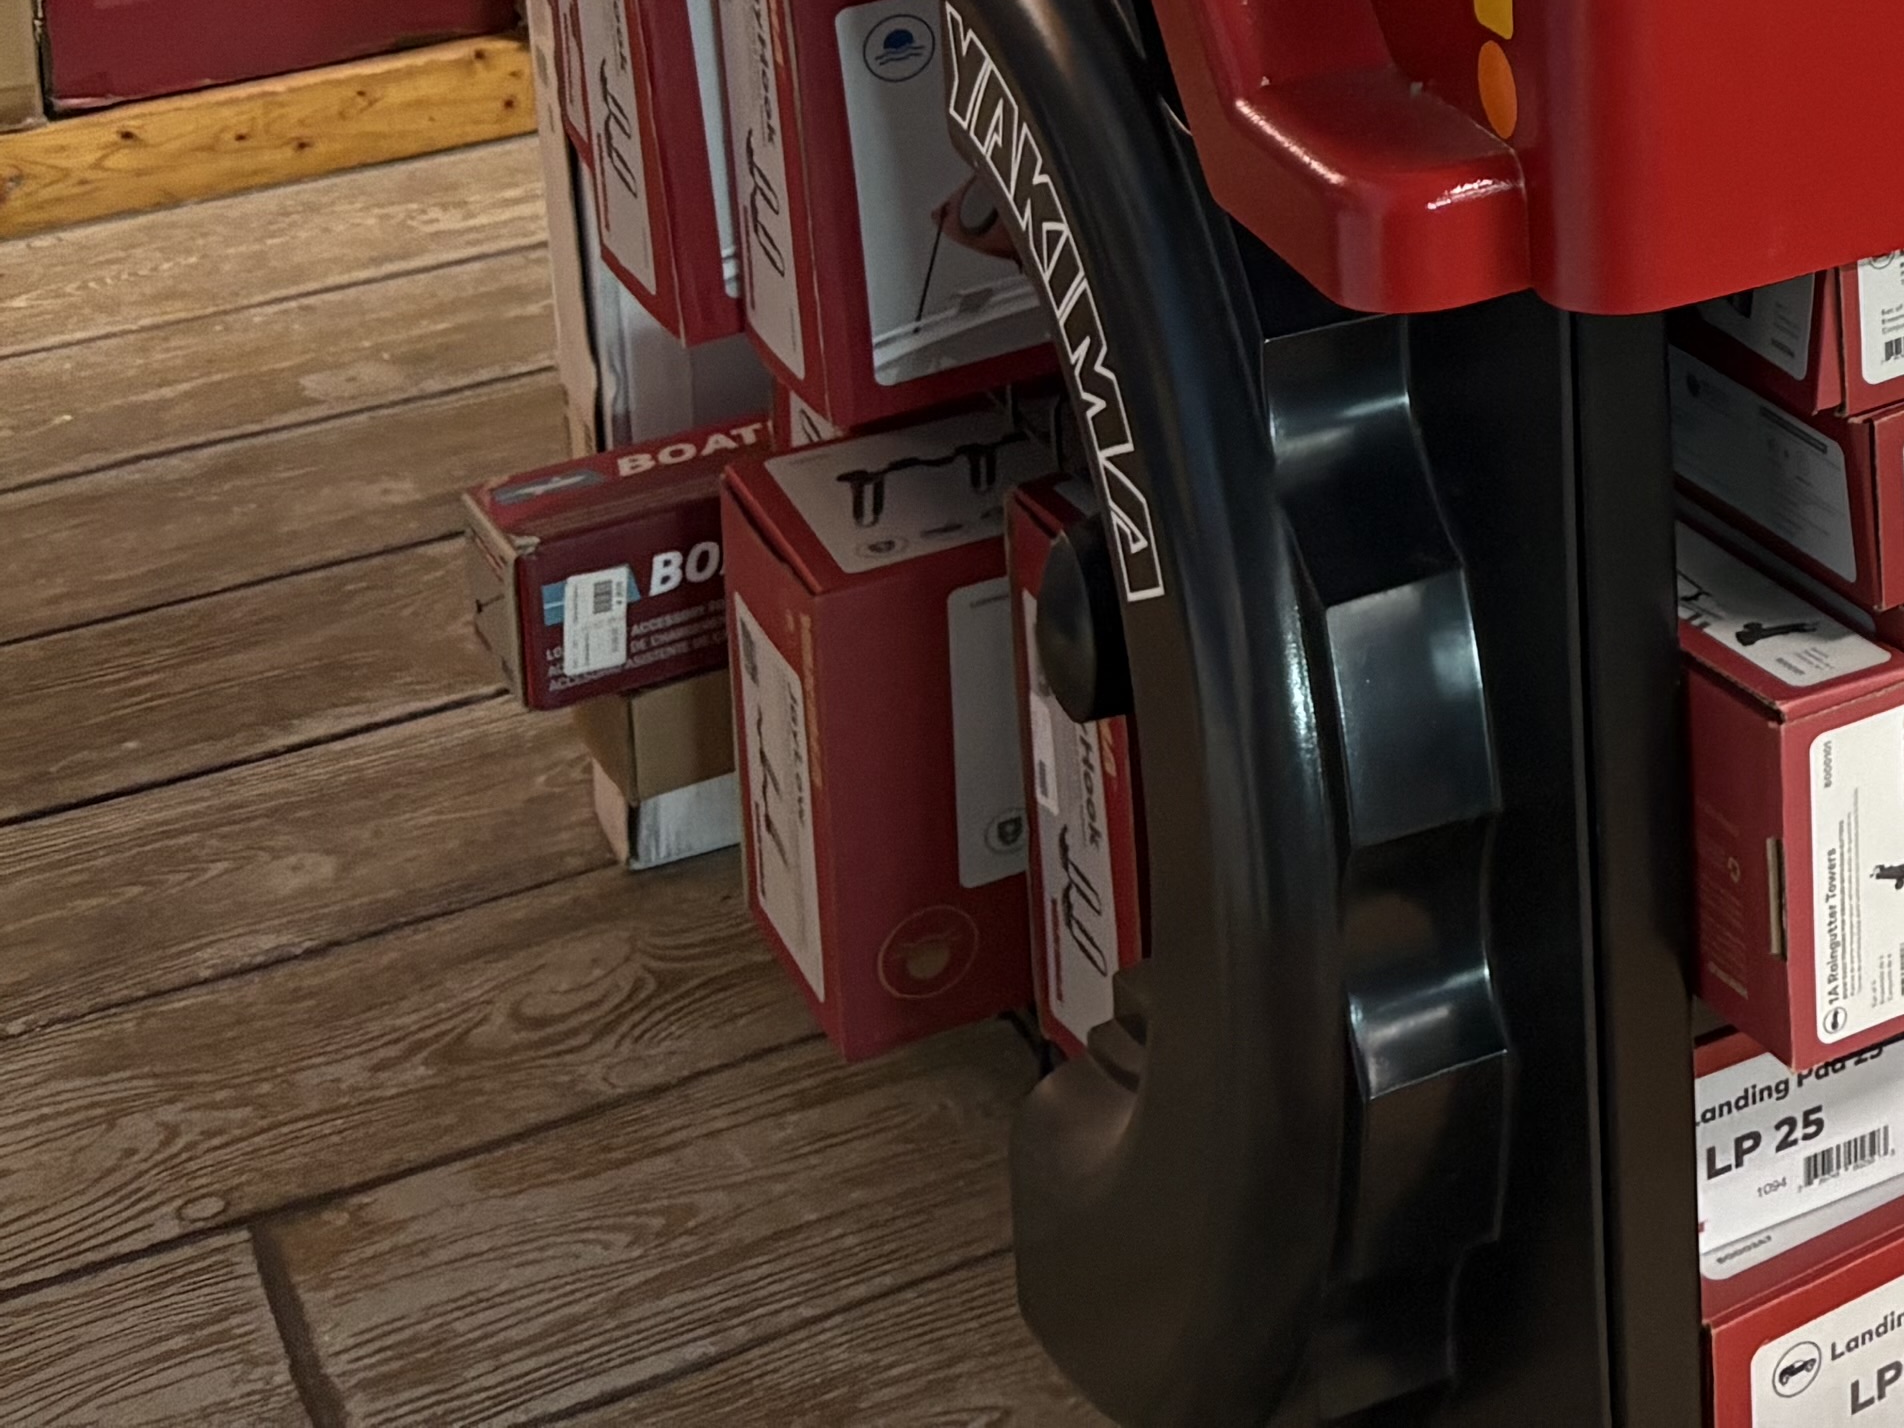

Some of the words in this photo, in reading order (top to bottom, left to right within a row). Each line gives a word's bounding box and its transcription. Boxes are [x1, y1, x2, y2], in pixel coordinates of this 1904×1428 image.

[943, 0, 1166, 604] YAKIMA
[1704, 1129, 1763, 1181] LP
[1775, 1107, 1825, 1156] 25
